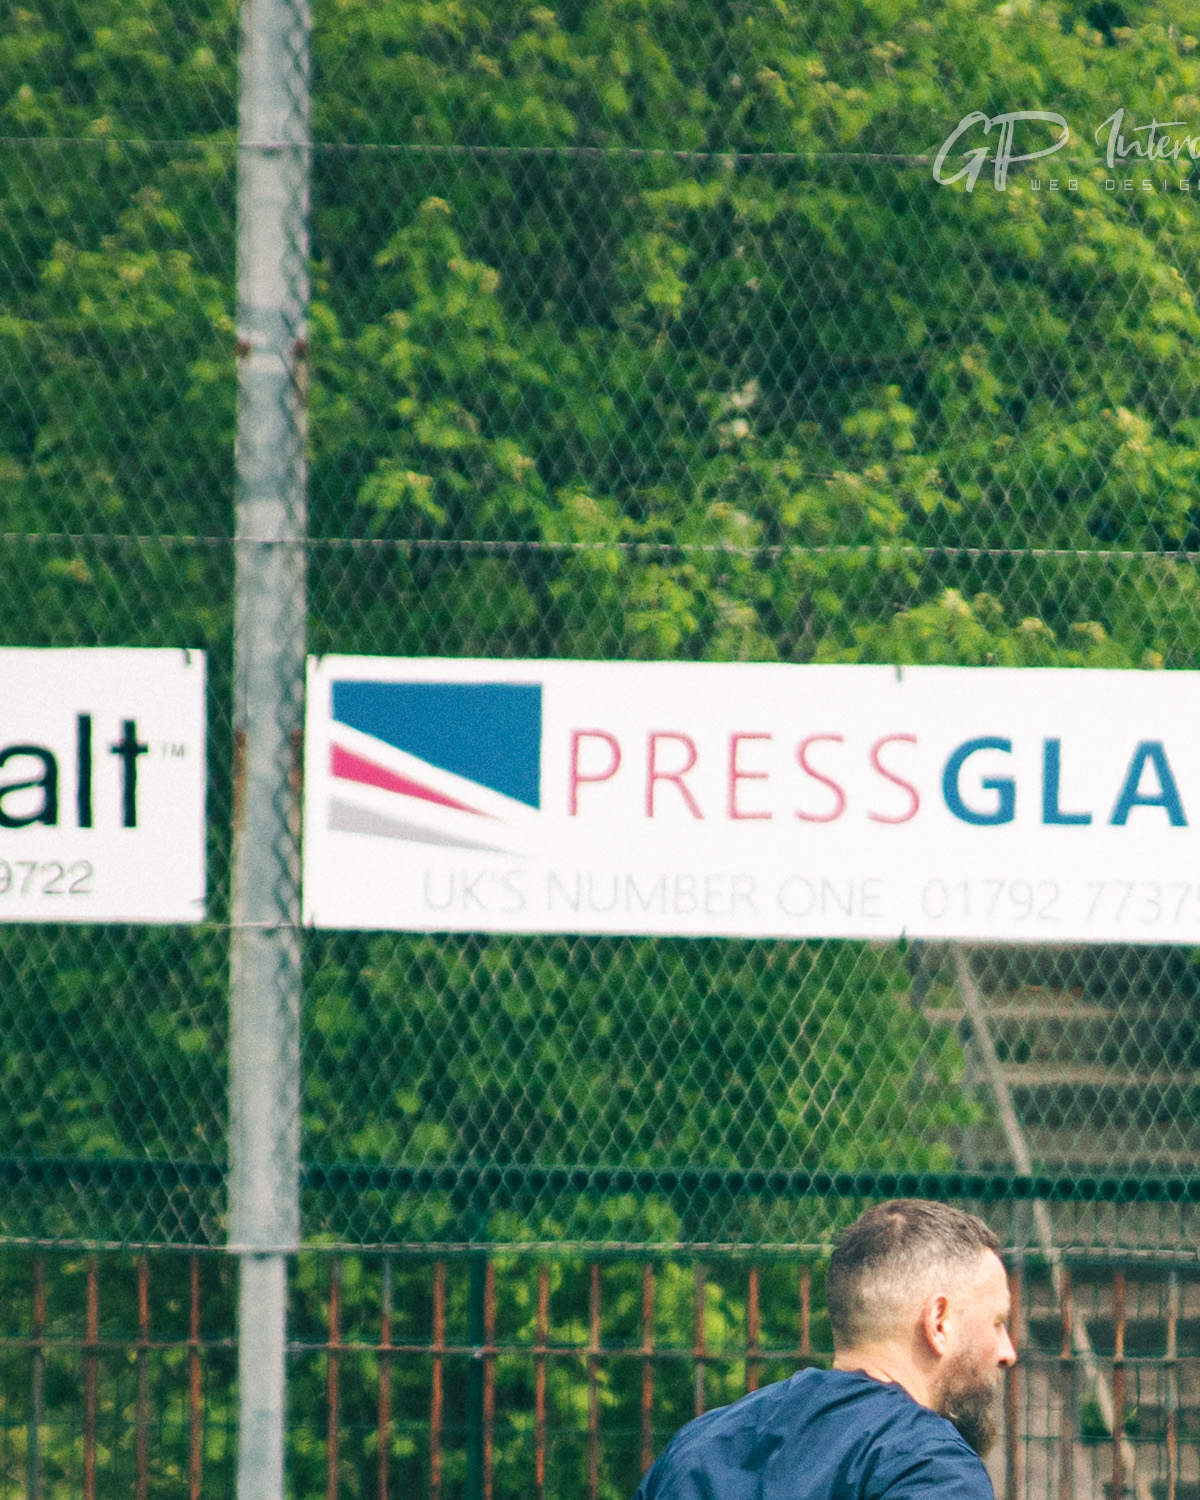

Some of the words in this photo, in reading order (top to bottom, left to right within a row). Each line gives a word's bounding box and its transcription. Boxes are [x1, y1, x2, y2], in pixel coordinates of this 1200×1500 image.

[547, 871, 757, 917] NUMBER
[777, 875, 882, 918] ONE
[921, 877, 1060, 921] 01792
